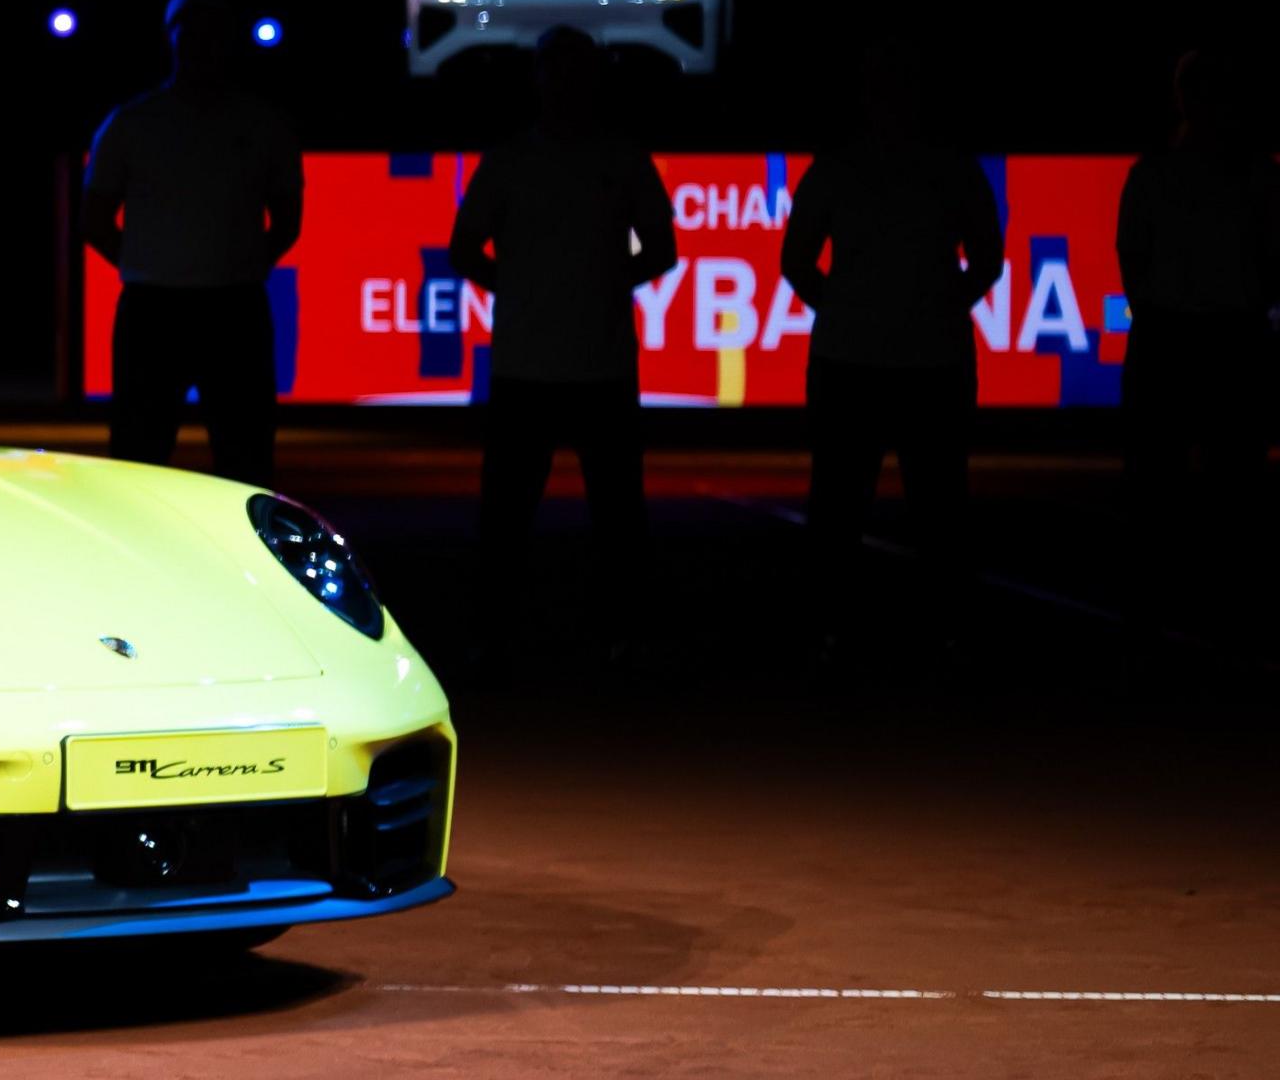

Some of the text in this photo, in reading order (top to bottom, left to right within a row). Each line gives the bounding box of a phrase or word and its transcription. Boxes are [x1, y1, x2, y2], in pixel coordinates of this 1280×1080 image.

[115, 758, 286, 779] 911 Carrera S
